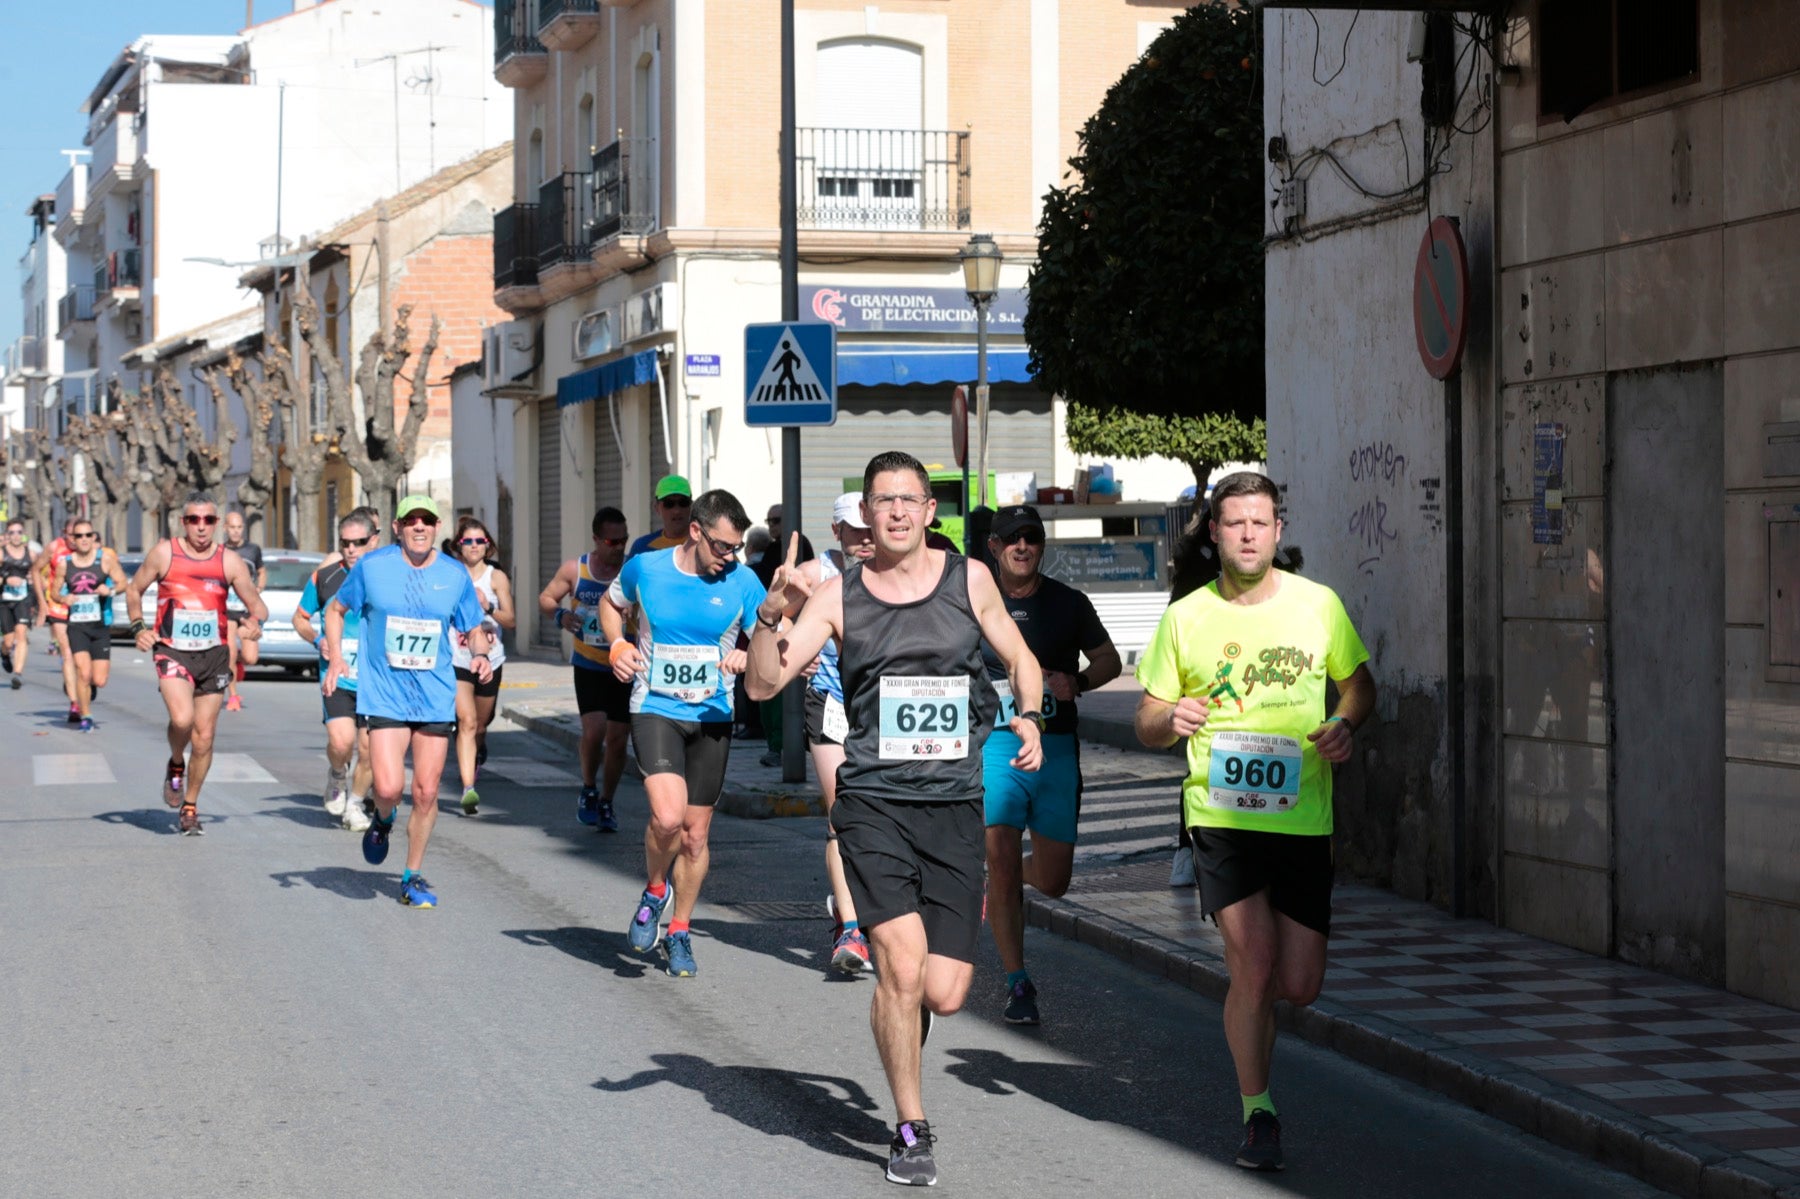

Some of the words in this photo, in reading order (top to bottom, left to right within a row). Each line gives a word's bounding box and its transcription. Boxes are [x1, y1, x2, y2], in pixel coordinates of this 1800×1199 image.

[851, 294, 936, 308] GRANADINA
[862, 308, 882, 321] DE
[885, 308, 995, 324] ELECTRICIDA,
[1086, 555, 1114, 566] papel
[1087, 565, 1142, 576] importante
[181, 621, 211, 637] 409
[396, 633, 432, 653] 177
[663, 663, 707, 685] 984
[904, 680, 919, 688] GRAN
[920, 680, 942, 688] PREMIO
[943, 680, 950, 688] DE
[896, 703, 959, 733] 629
[1250, 735, 1271, 745] PREMIO
[1224, 756, 1286, 789] 960
